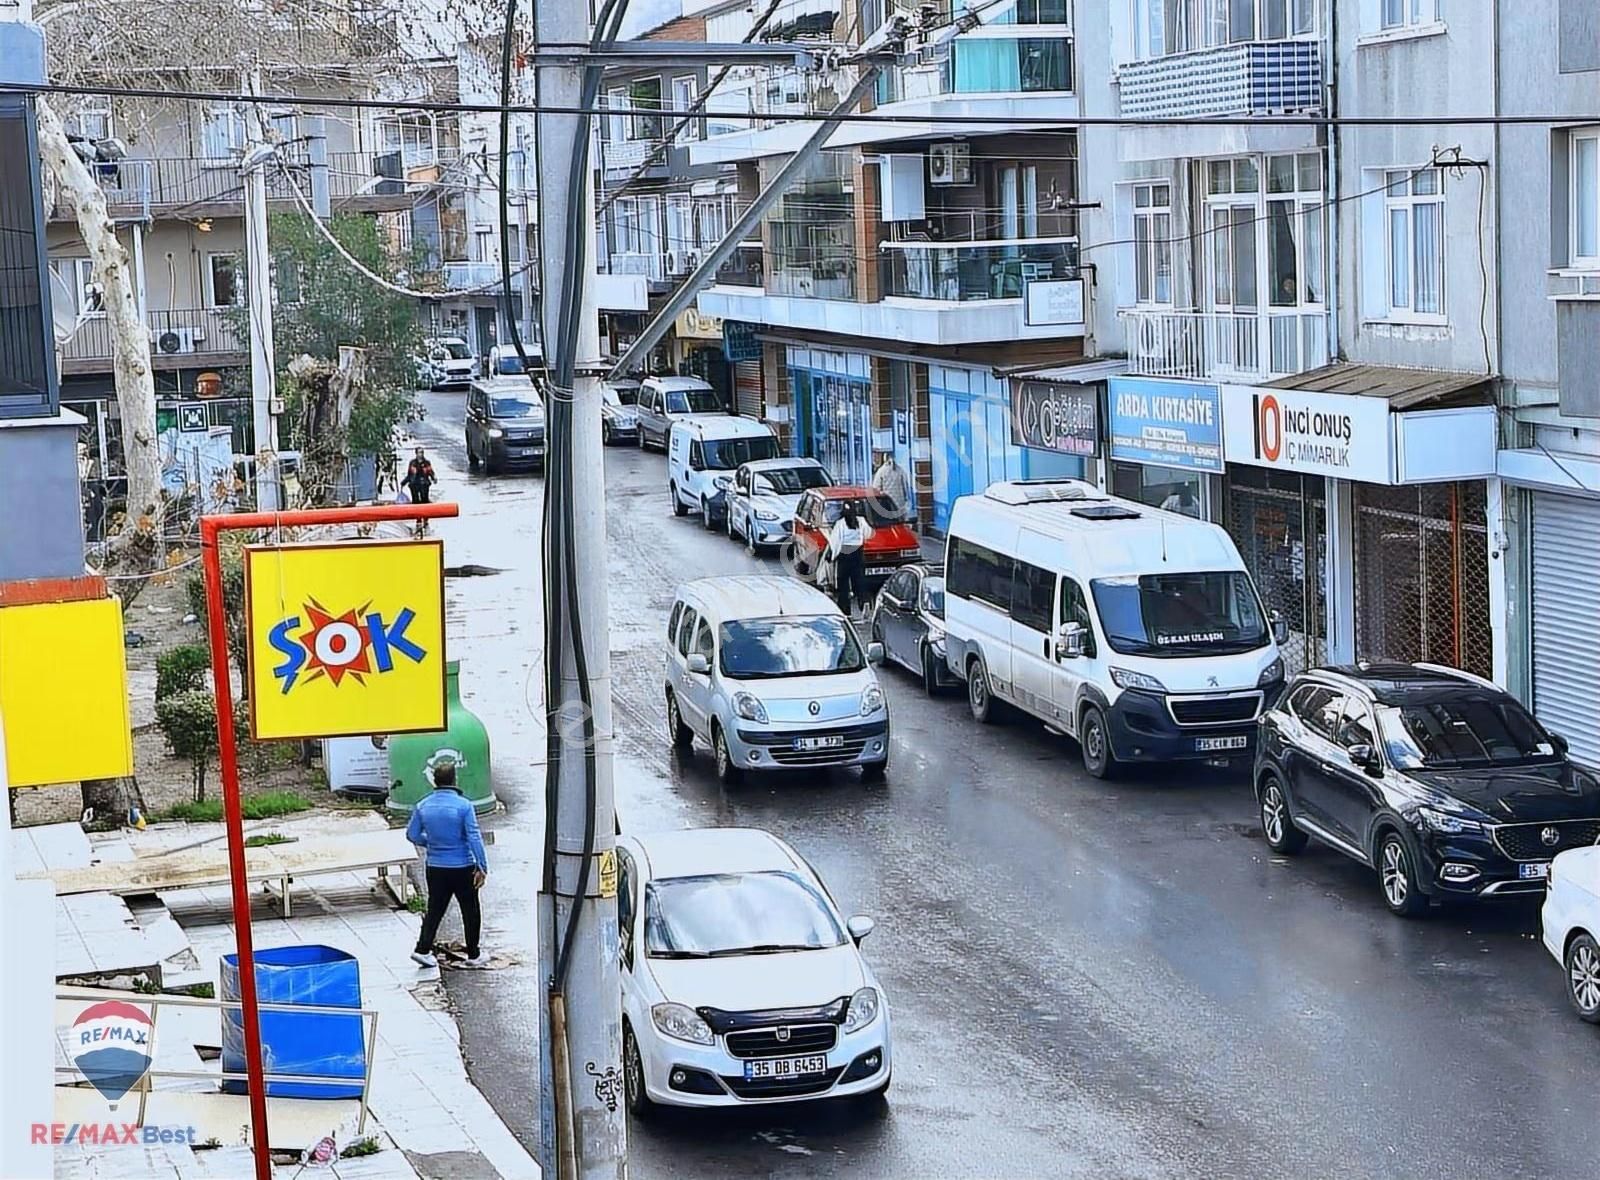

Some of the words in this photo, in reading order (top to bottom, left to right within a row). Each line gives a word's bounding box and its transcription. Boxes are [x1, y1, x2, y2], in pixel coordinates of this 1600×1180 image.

[1116, 393, 1150, 419] ARDA
[1152, 392, 1213, 426] KIRTASİYE
[1284, 405, 1310, 435] İNCİ
[1313, 412, 1352, 445] ONUŞ
[1285, 437, 1297, 465] İÇ
[1298, 440, 1350, 468] MİMARLIK
[269, 607, 428, 695] ŞOK
[1526, 865, 1538, 876] 35
[754, 1061, 769, 1076] 35
[794, 1057, 824, 1072] 6453
